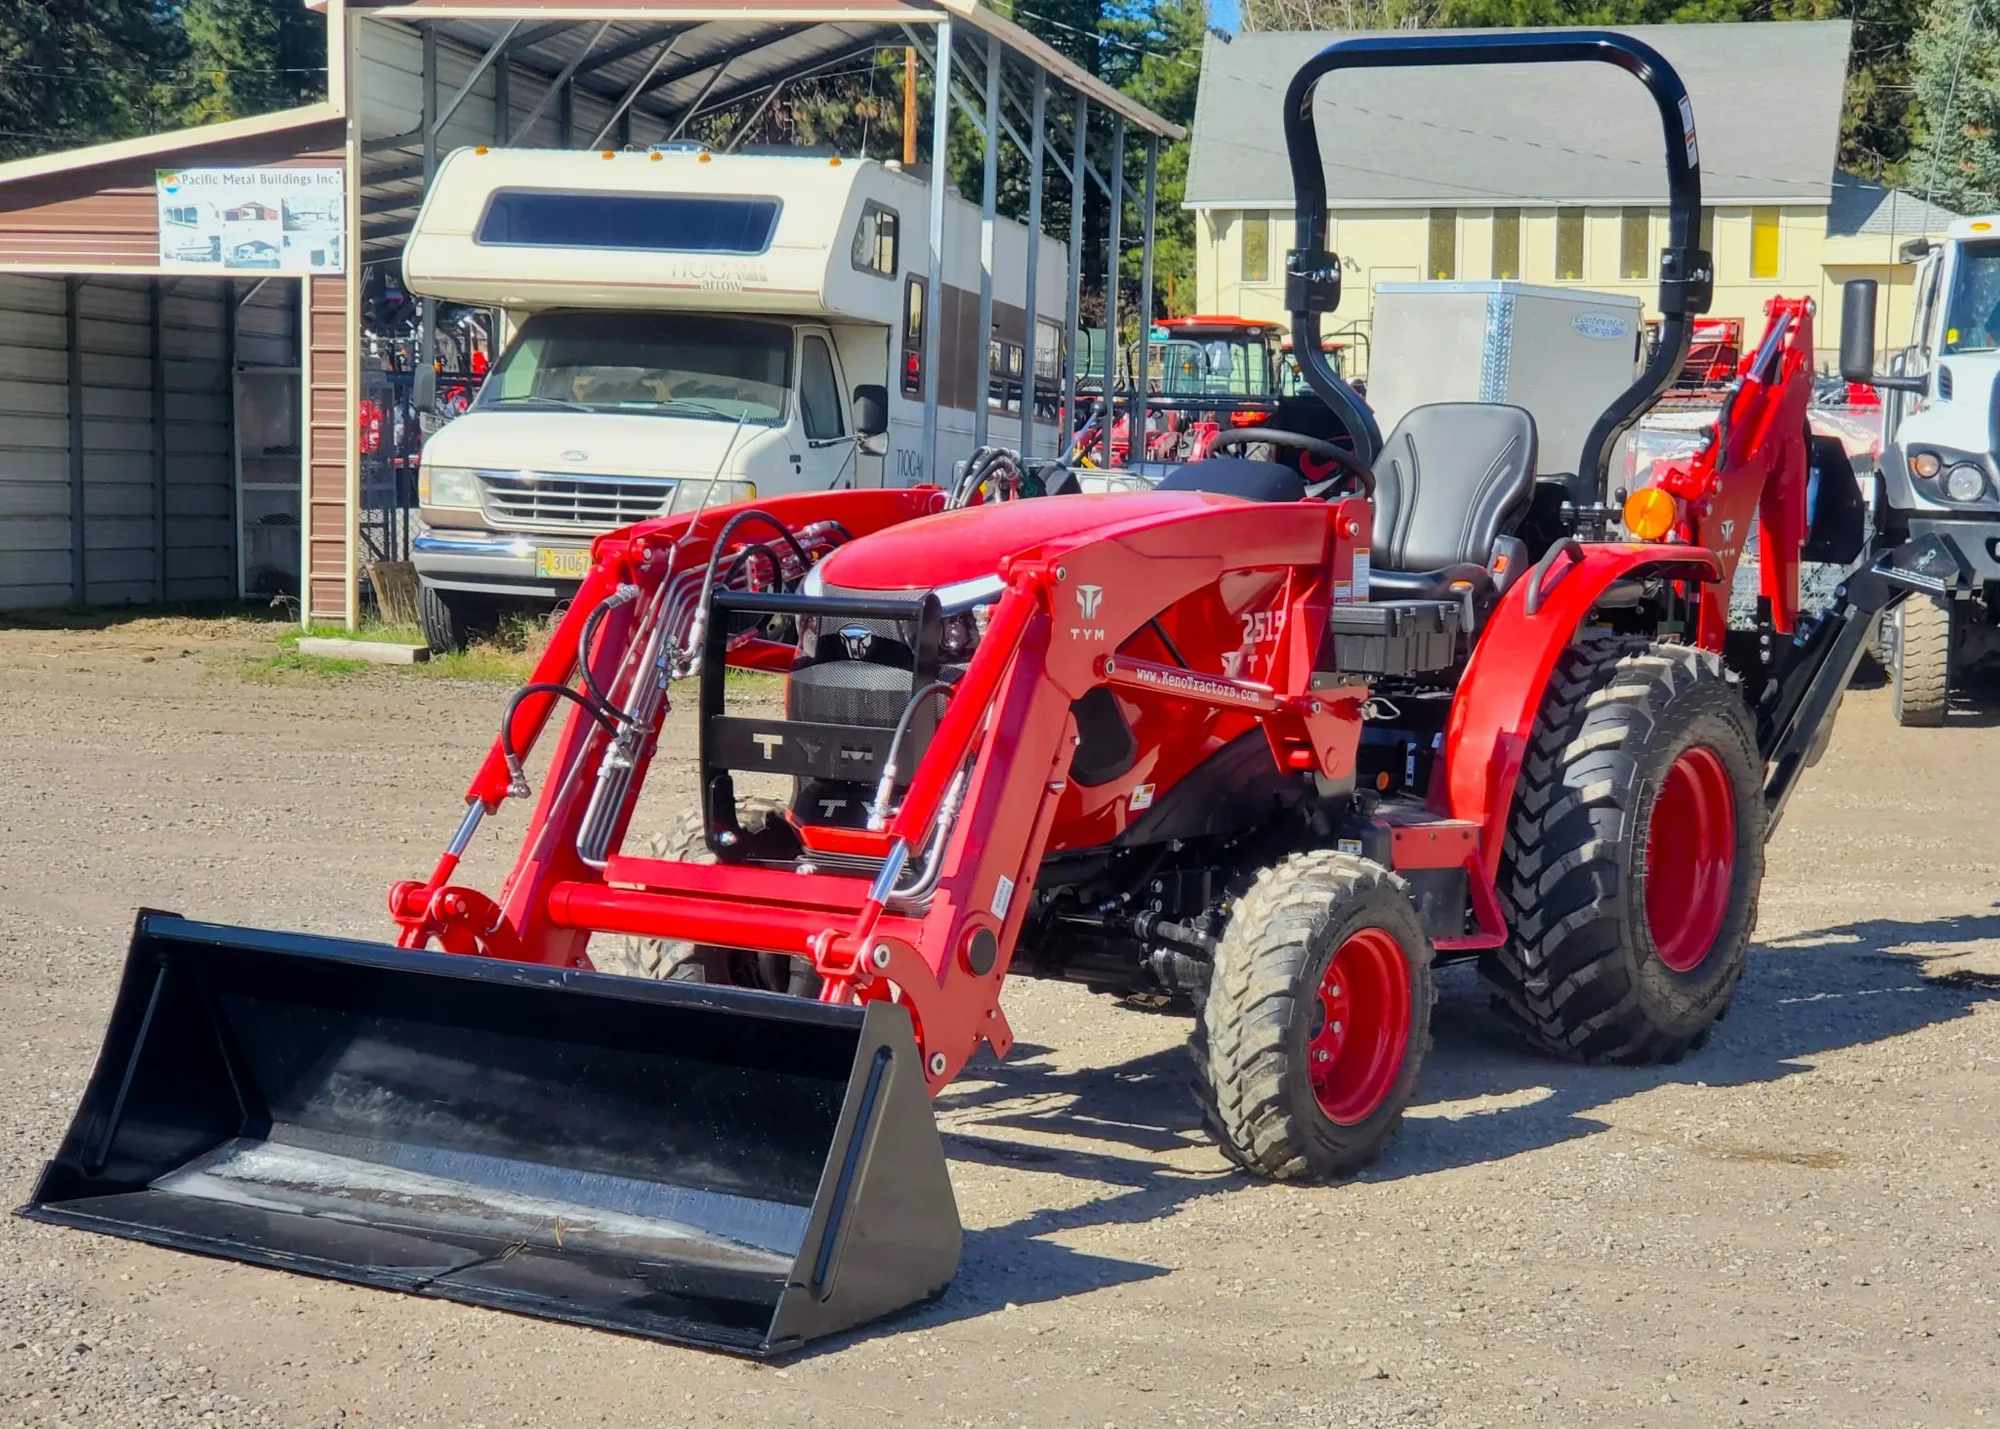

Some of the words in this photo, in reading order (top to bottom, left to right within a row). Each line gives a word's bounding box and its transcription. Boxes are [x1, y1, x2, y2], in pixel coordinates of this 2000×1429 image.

[182, 173, 219, 185] Pacific
[223, 174, 255, 185] Metal
[260, 174, 312, 186] Buildings
[317, 174, 339, 184] Inc.
[702, 280, 741, 291] arrow
[1070, 629, 1105, 641] TYM
[1136, 668, 1260, 702] www.KenoTractors.com
